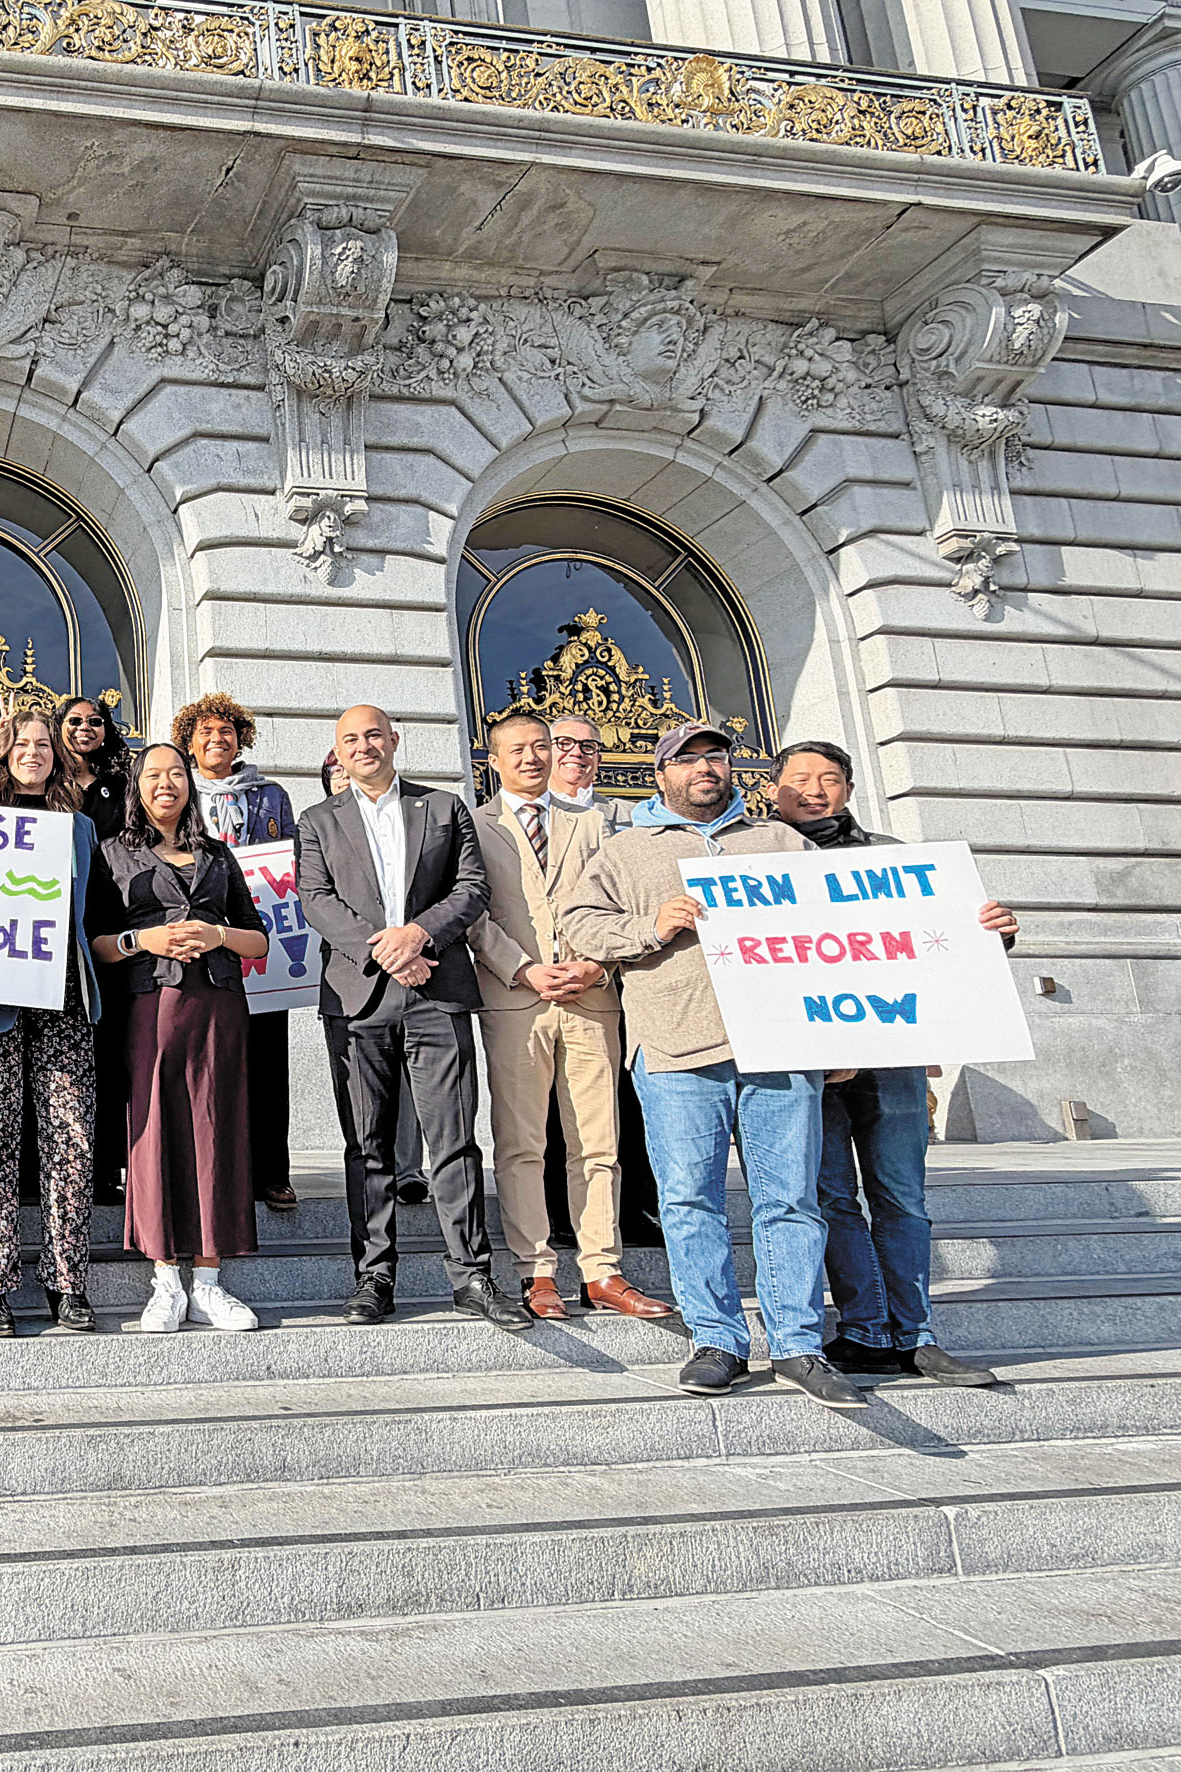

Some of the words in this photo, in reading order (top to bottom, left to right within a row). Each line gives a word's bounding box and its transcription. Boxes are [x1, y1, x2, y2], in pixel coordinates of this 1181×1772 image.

[686, 873, 798, 908] TERM
[824, 863, 937, 903] LIMIT
[736, 930, 917, 965] REFORM
[802, 993, 918, 1025] NOW
